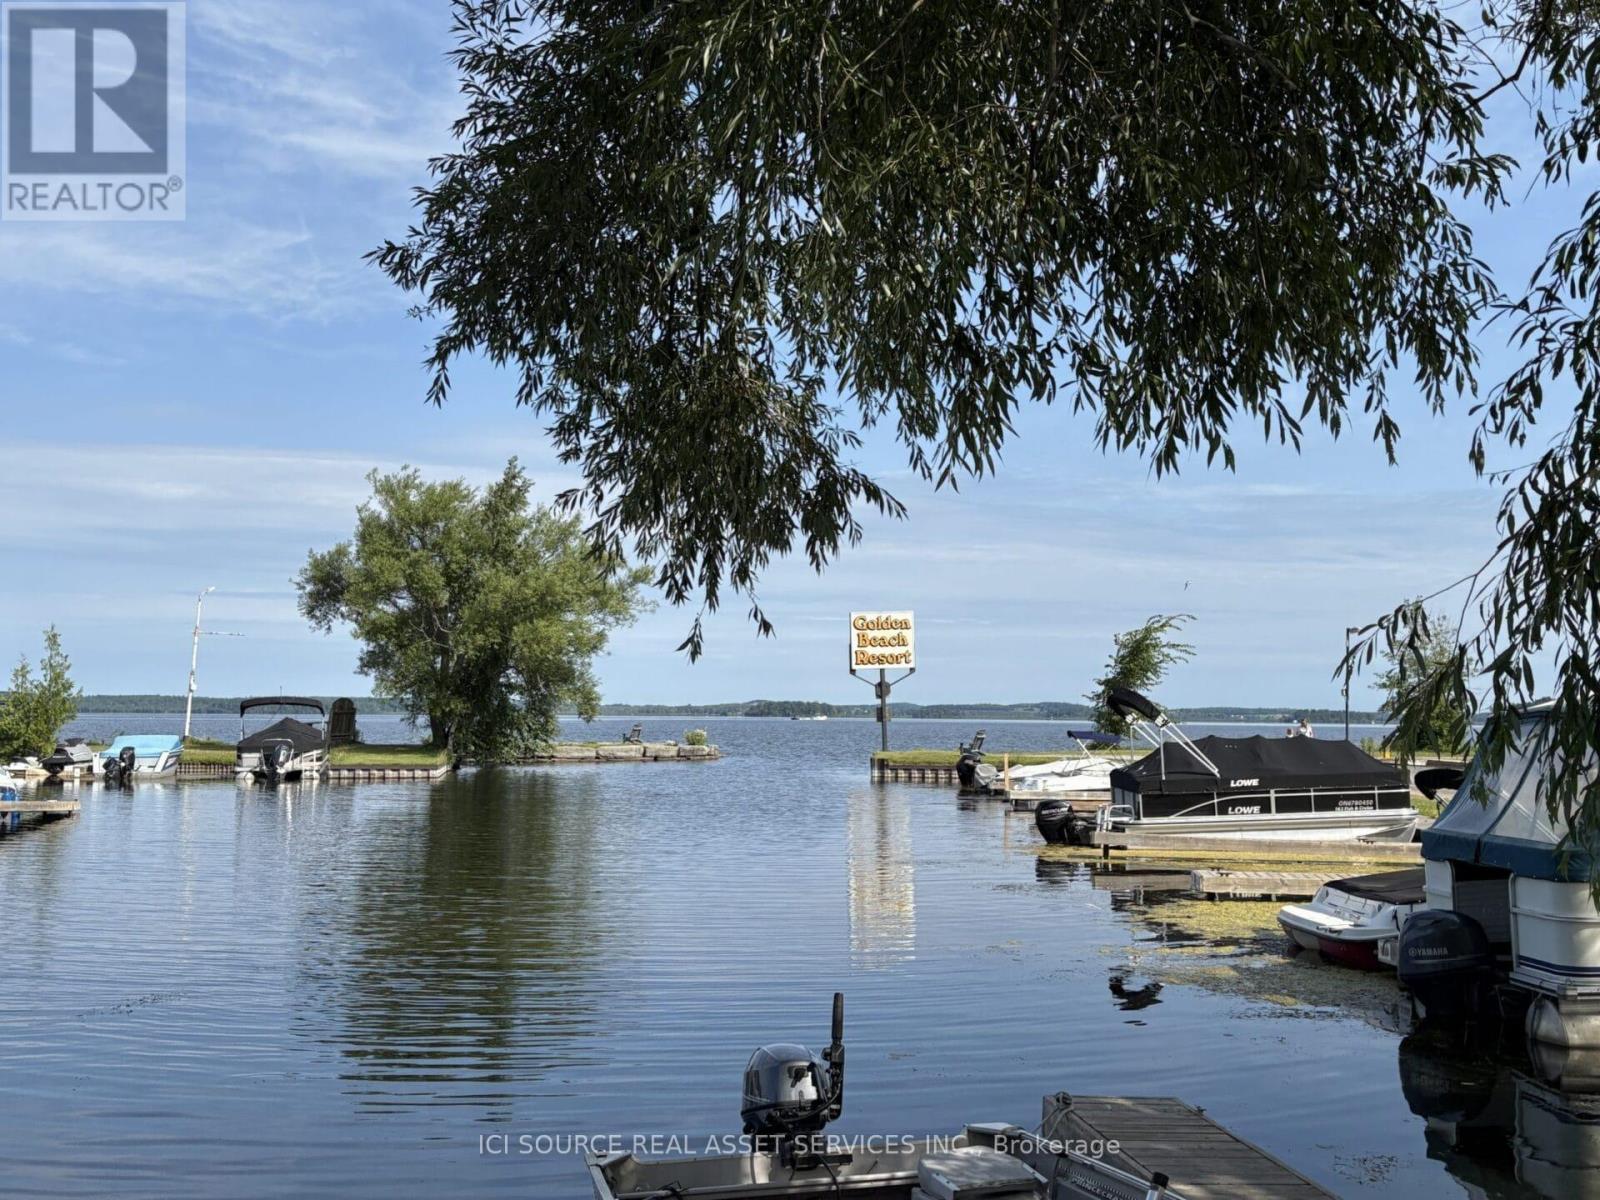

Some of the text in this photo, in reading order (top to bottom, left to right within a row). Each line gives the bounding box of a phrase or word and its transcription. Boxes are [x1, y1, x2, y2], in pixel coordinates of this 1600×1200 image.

[853, 615, 911, 631] Golden
[857, 632, 908, 648] Beach
[854, 650, 912, 665] Resort
[1230, 778, 1260, 787] LOWE
[1228, 805, 1261, 815] LOWE
[1417, 946, 1449, 956] YAMAHA
